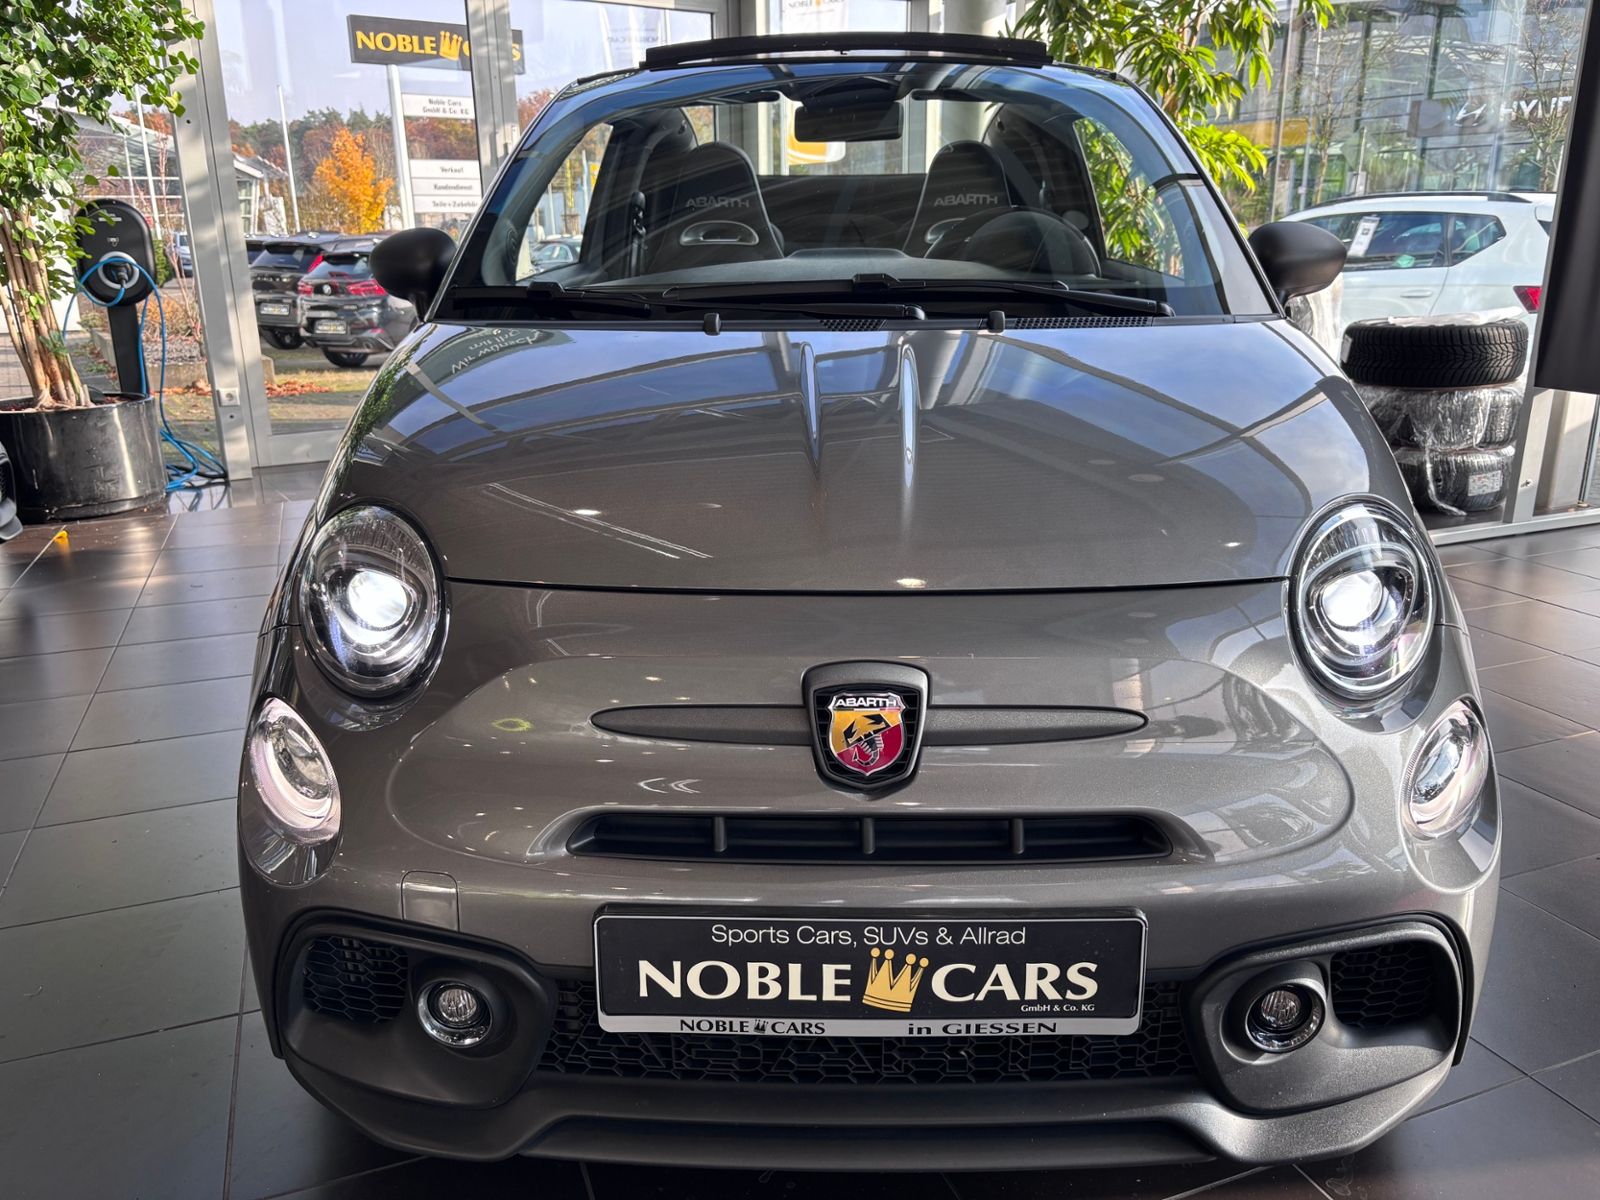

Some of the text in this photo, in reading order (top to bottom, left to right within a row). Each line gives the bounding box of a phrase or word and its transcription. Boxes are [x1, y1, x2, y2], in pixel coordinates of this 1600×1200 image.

[355, 30, 437, 55] NOBLE
[685, 196, 750, 208] ABARTH
[934, 193, 999, 207] ABARTH
[835, 698, 897, 707] ABARTH
[711, 924, 1026, 948] Sports Cars, SUVs & Allrad
[638, 960, 1099, 1002] NOBLE CARS
[1020, 1003, 1095, 1012] GmbH & Co. KG
[680, 1019, 1057, 1035] NOBLE CARS in GIESSEN
